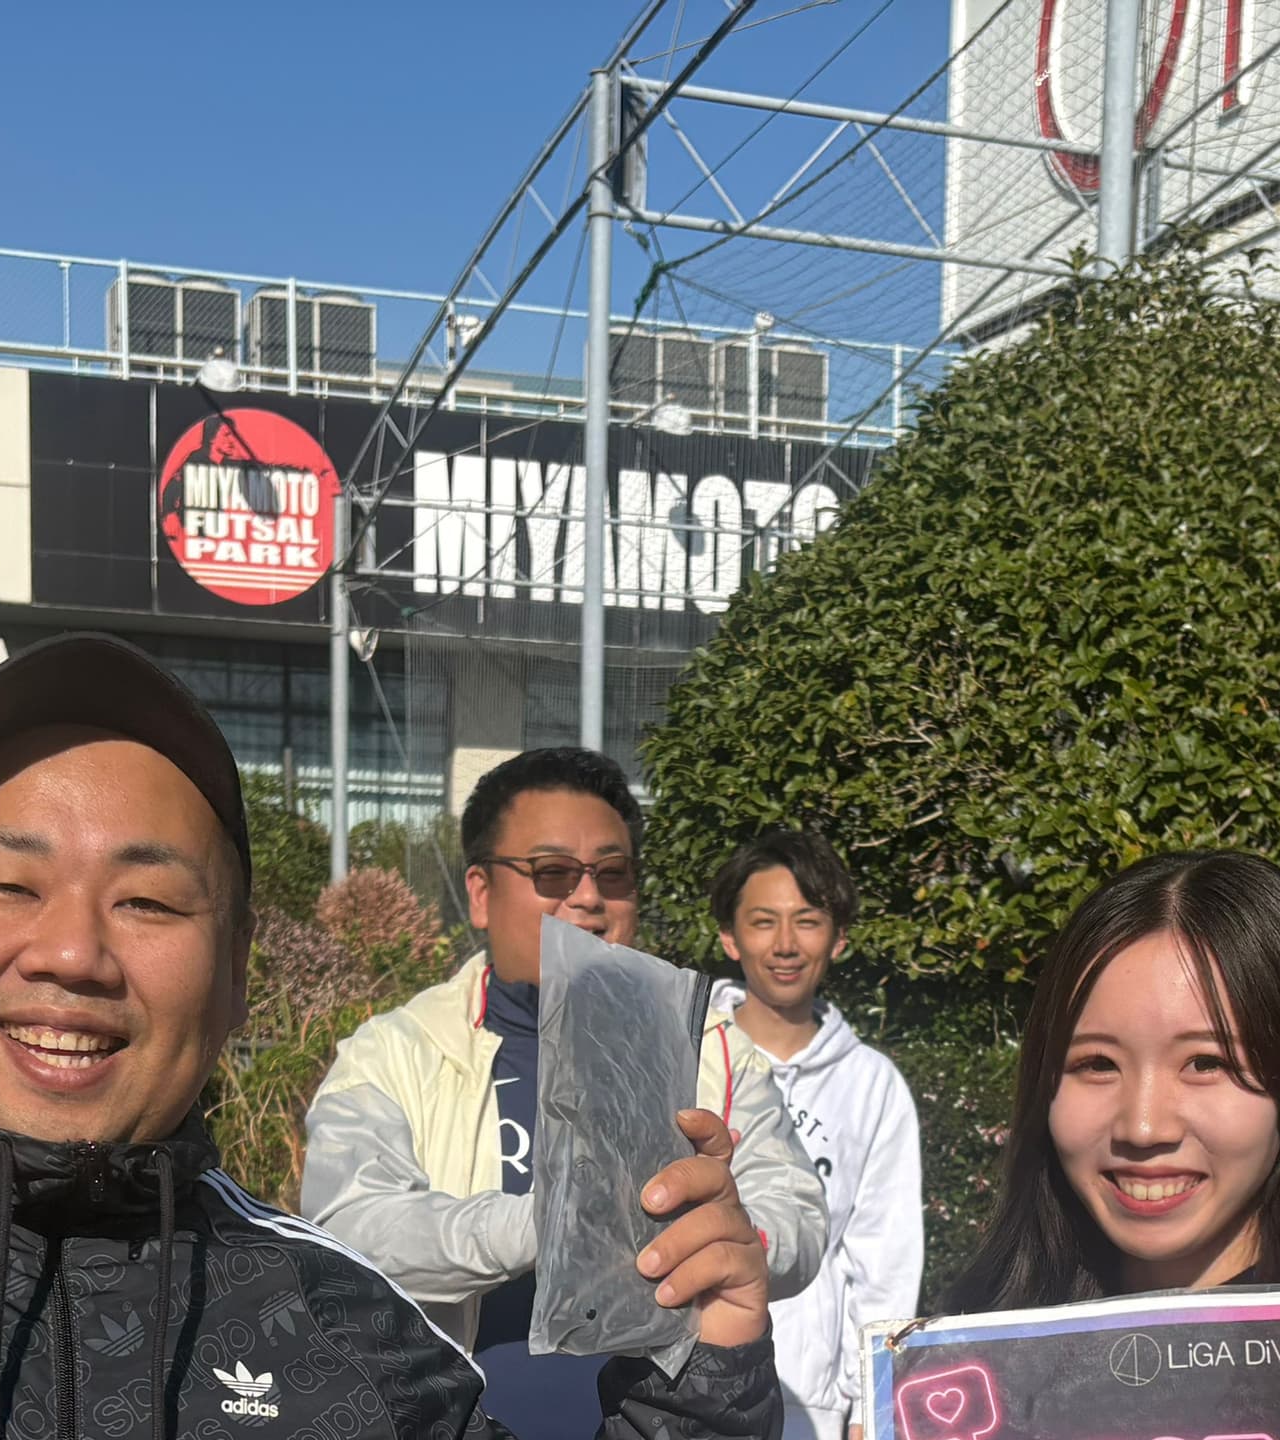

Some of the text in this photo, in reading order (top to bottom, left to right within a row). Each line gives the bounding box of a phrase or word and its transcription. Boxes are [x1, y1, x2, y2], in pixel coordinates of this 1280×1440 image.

[184, 463, 320, 516] MIYAMOTO
[184, 510, 320, 545] FUTSAL
[184, 538, 320, 568] PARK
[220, 1398, 280, 1419] adidas
